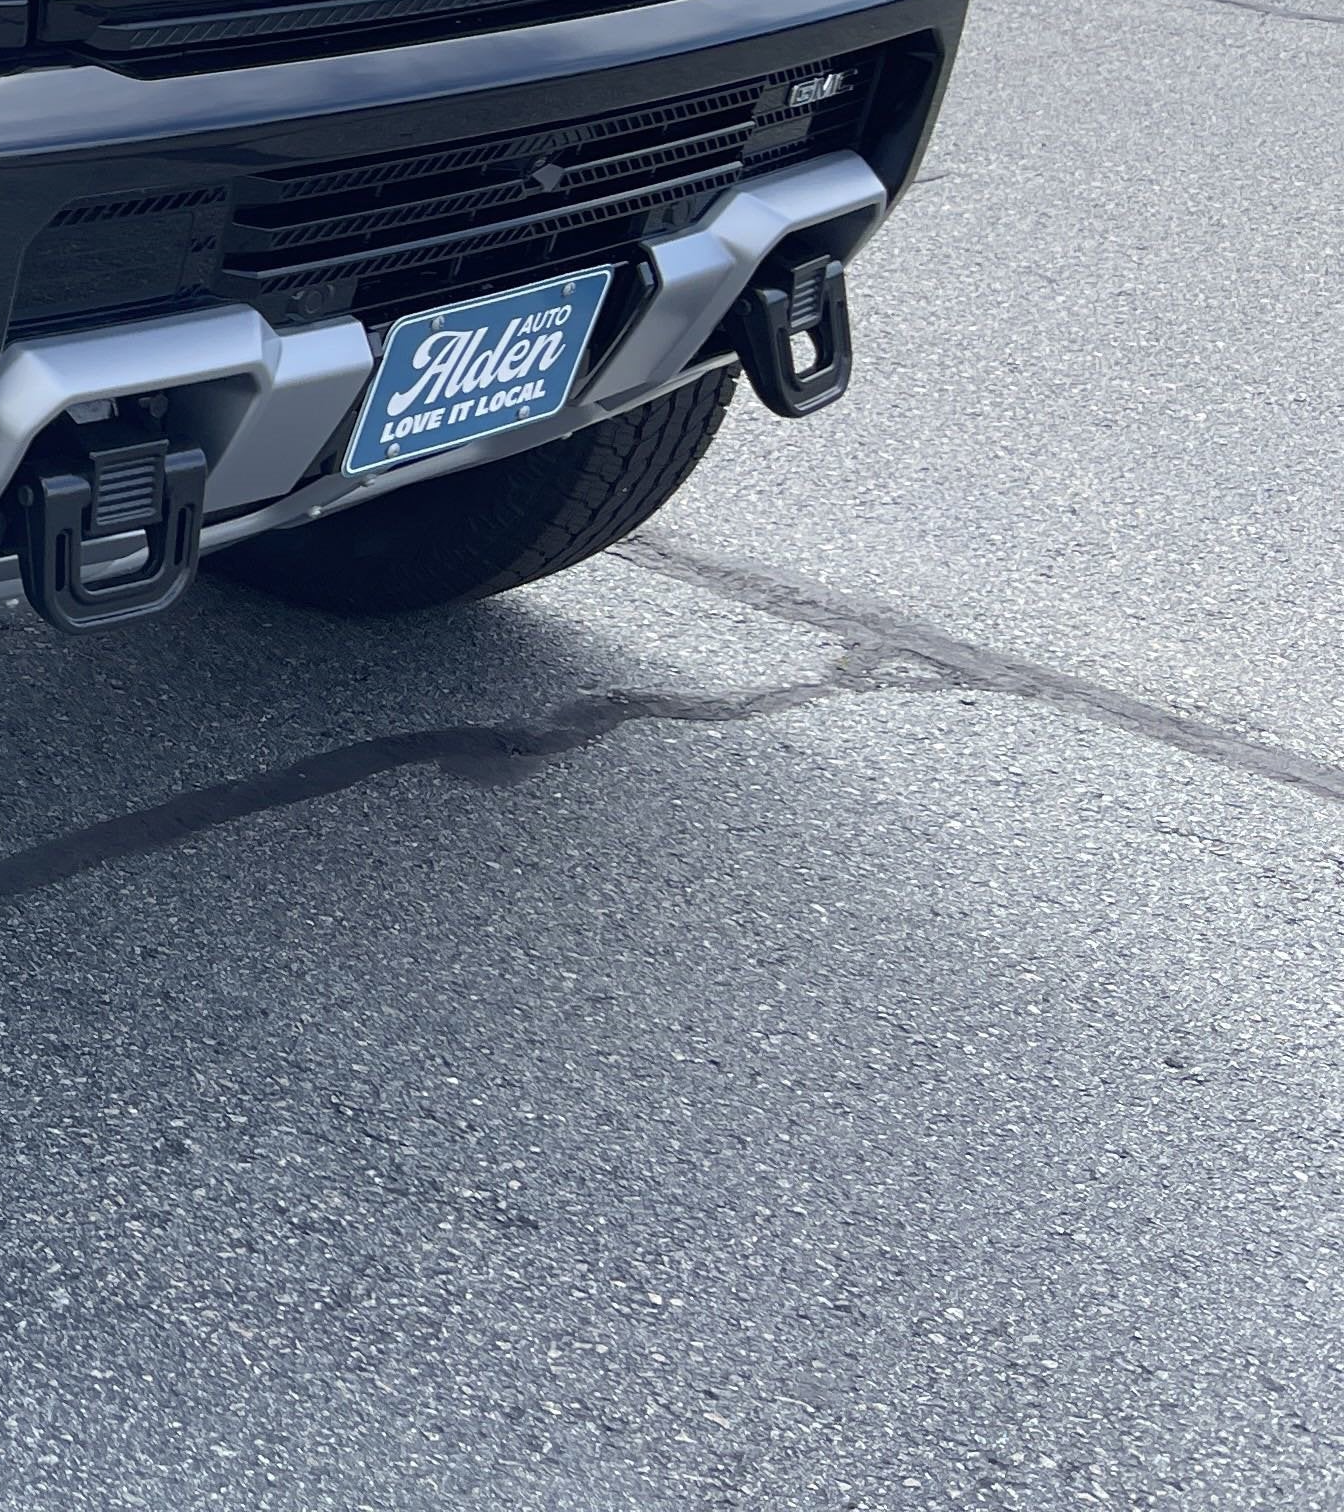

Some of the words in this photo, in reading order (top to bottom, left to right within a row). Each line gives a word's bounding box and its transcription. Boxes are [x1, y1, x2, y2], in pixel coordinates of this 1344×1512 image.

[789, 69, 858, 107] GMC
[517, 304, 573, 336] AUTO
[386, 317, 567, 417] Alden
[379, 407, 446, 444] LOVE
[447, 400, 475, 426] IT
[474, 378, 546, 418] LOCAL
